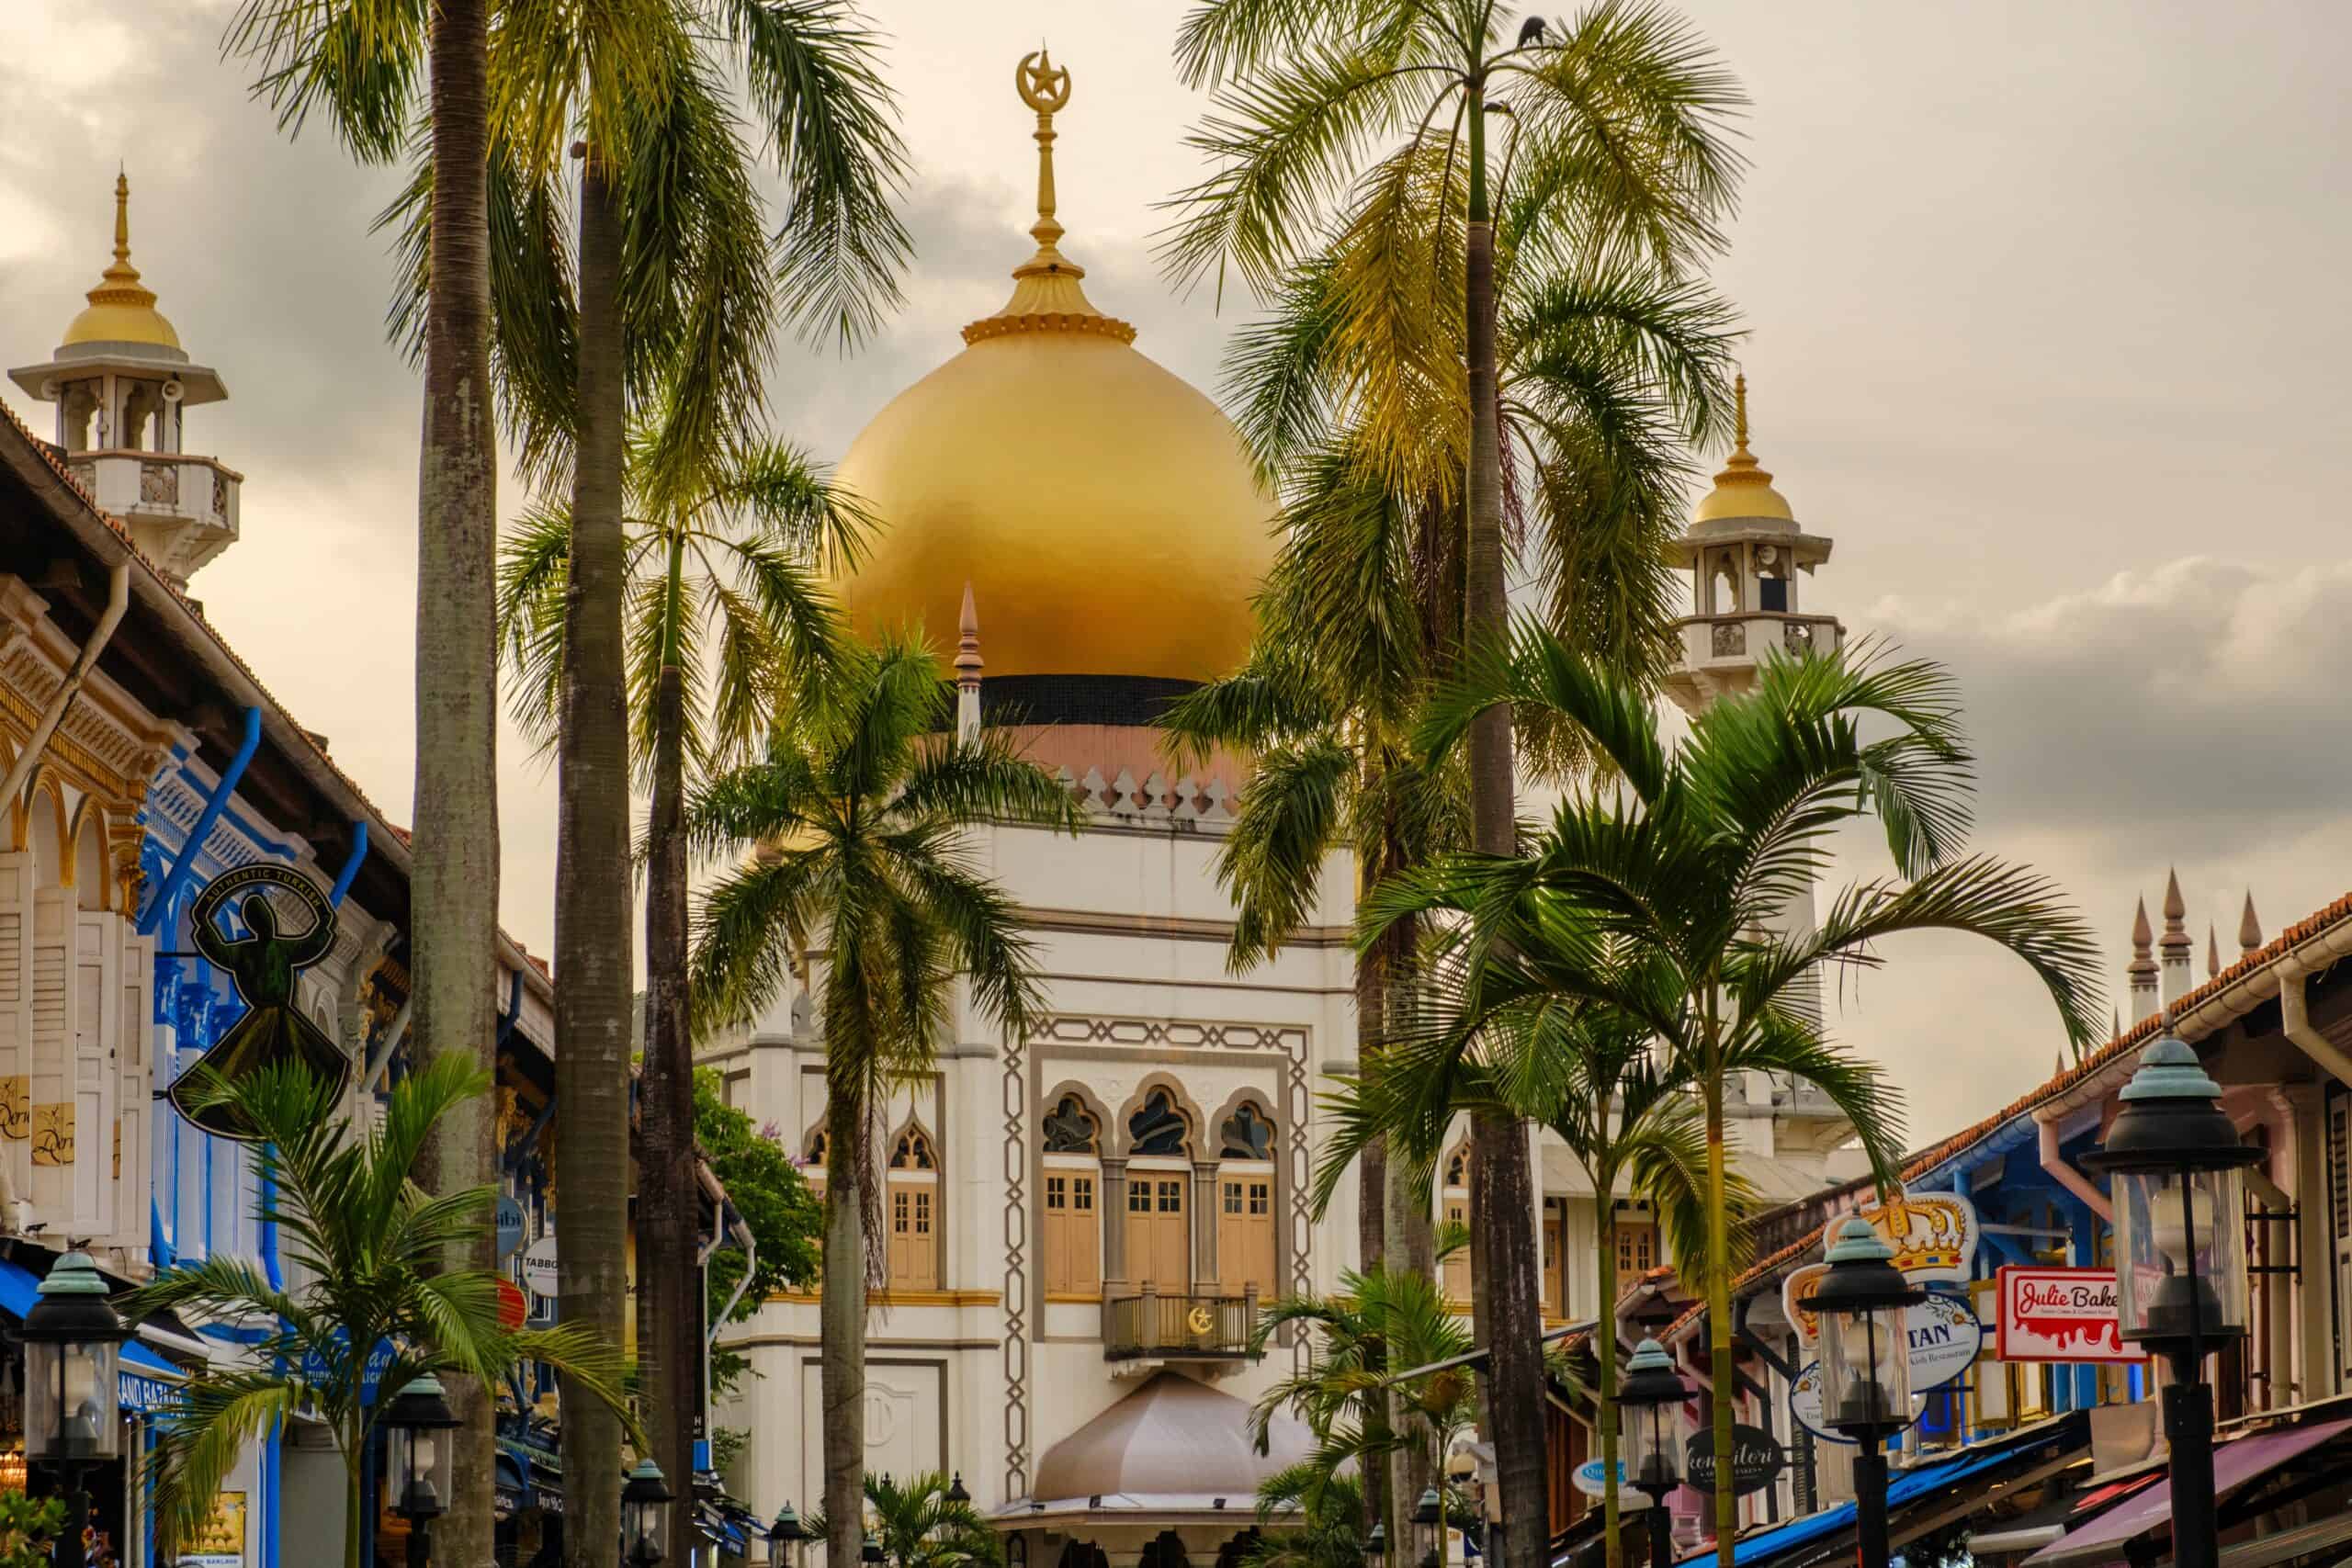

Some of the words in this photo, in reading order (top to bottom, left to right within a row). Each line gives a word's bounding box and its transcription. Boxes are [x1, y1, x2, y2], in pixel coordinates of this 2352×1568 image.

[206, 868, 272, 903] AUTHENTIC
[276, 870, 323, 909] TURKISH
[526, 1257, 559, 1269] TABBO
[2019, 1281, 2070, 1314] Julie
[2071, 1285, 2118, 1308] Bake
[1907, 1324, 1951, 1348] TAN
